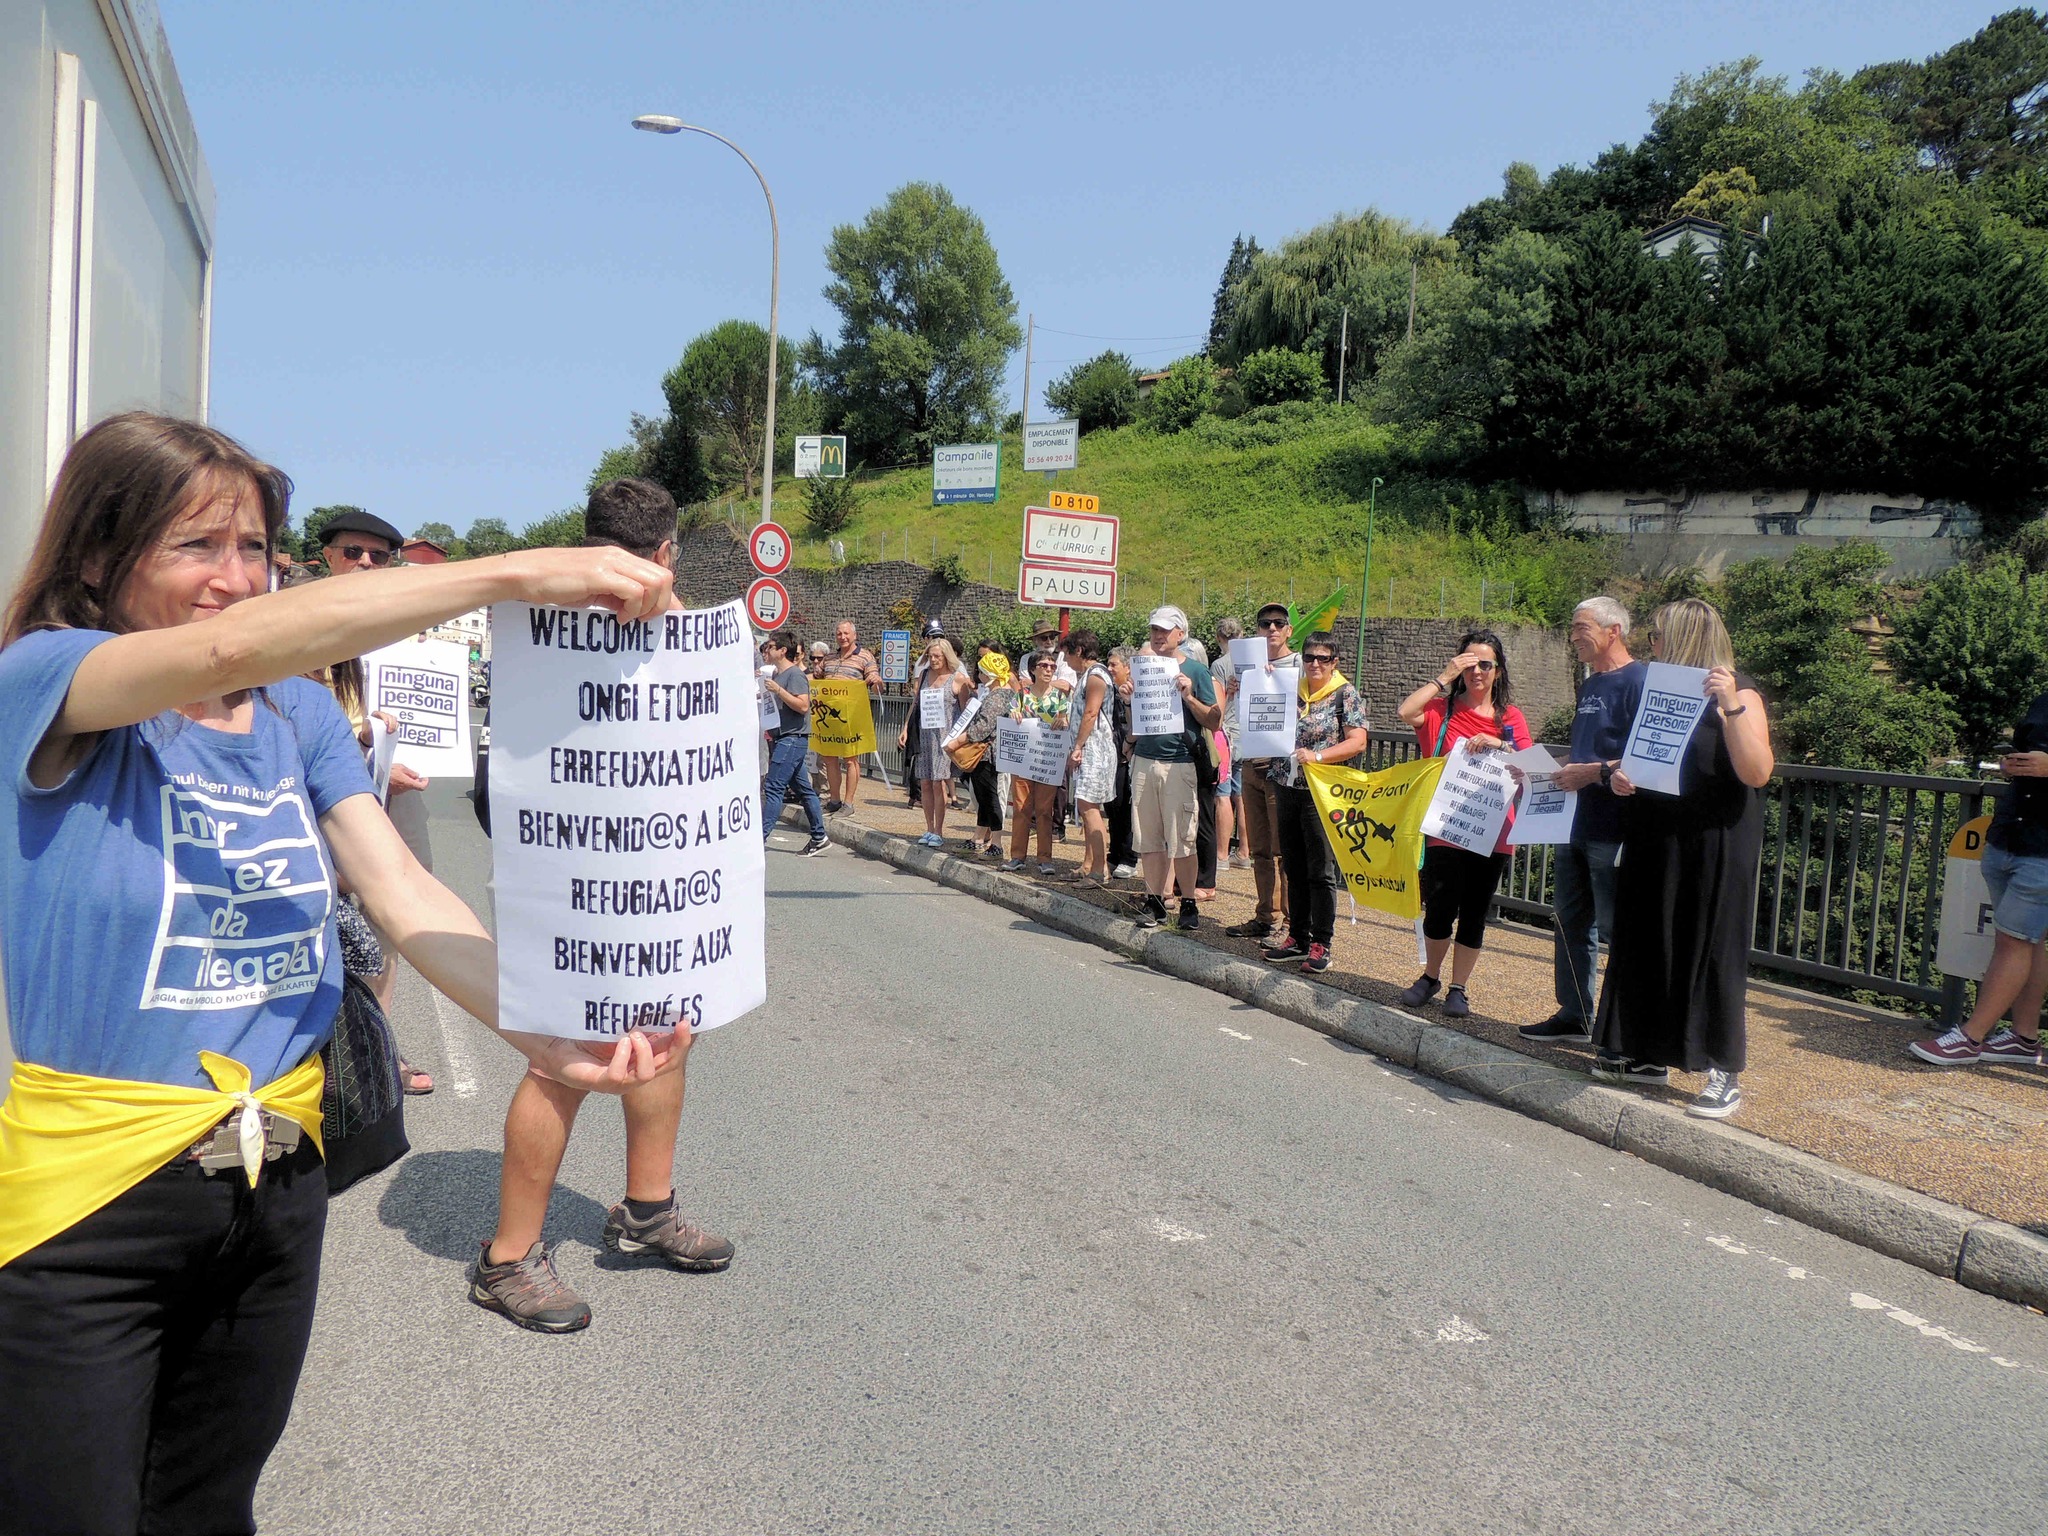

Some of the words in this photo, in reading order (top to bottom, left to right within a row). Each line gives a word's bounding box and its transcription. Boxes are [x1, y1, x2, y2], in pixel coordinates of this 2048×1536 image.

[1028, 428, 1074, 438] EMPLACEMENT
[1032, 439, 1068, 448] DISPONIBLE
[937, 449, 993, 464] Campanile
[1054, 495, 1062, 507] D
[1067, 496, 1094, 510] 810
[1032, 576, 1106, 596] PAUSU
[530, 607, 654, 655] WELCOME
[665, 605, 740, 653] REFUGEES
[884, 632, 907, 640] FRANCE
[385, 667, 454, 691] ninguna
[385, 690, 453, 711] persona
[578, 681, 638, 723] ONGI
[648, 678, 719, 722] ETORRI
[821, 686, 849, 696] etorri
[1251, 694, 1268, 703] inor
[1650, 692, 1698, 714] ninguna
[399, 710, 415, 721] es
[1258, 712, 1268, 721] da
[1645, 712, 1690, 732] persona
[400, 722, 441, 745] ilegal
[1002, 730, 1029, 741] ningun
[1255, 722, 1283, 731] ilegala
[1650, 731, 1662, 741] es
[1646, 742, 1671, 760] ilegal
[550, 738, 735, 788] ERREFUXIATUAK
[1467, 758, 1482, 771] ONGI
[1482, 763, 1504, 776] ETORRI
[1330, 783, 1370, 805] Ongi
[1371, 778, 1410, 799] etorri
[1456, 769, 1504, 793] ERREFUXIATUAK
[1443, 781, 1483, 804] BIENVENID@S
[1483, 796, 1489, 805] A
[1489, 797, 1504, 811] L@S
[1539, 793, 1550, 803] da
[1449, 800, 1487, 821] REFUGIAD@S
[1534, 803, 1563, 814] ilegala
[519, 807, 688, 854] BIENVENID@S
[695, 814, 711, 847] A
[718, 794, 751, 841] L@S
[1439, 812, 1471, 833] BIENVENUE
[1471, 822, 1486, 837] AUX
[1965, 830, 1980, 851] D
[235, 858, 291, 892] ez
[571, 869, 721, 916] REFUGIAD@S
[210, 898, 248, 937] da
[554, 936, 683, 978] BIENVENUE
[691, 924, 732, 970] AUX
[194, 940, 311, 991] ilegala
[150, 992, 177, 1004] ARGIA
[226, 990, 256, 1003] MOYE
[584, 993, 703, 1036] RÉFUGIÉ.ES
